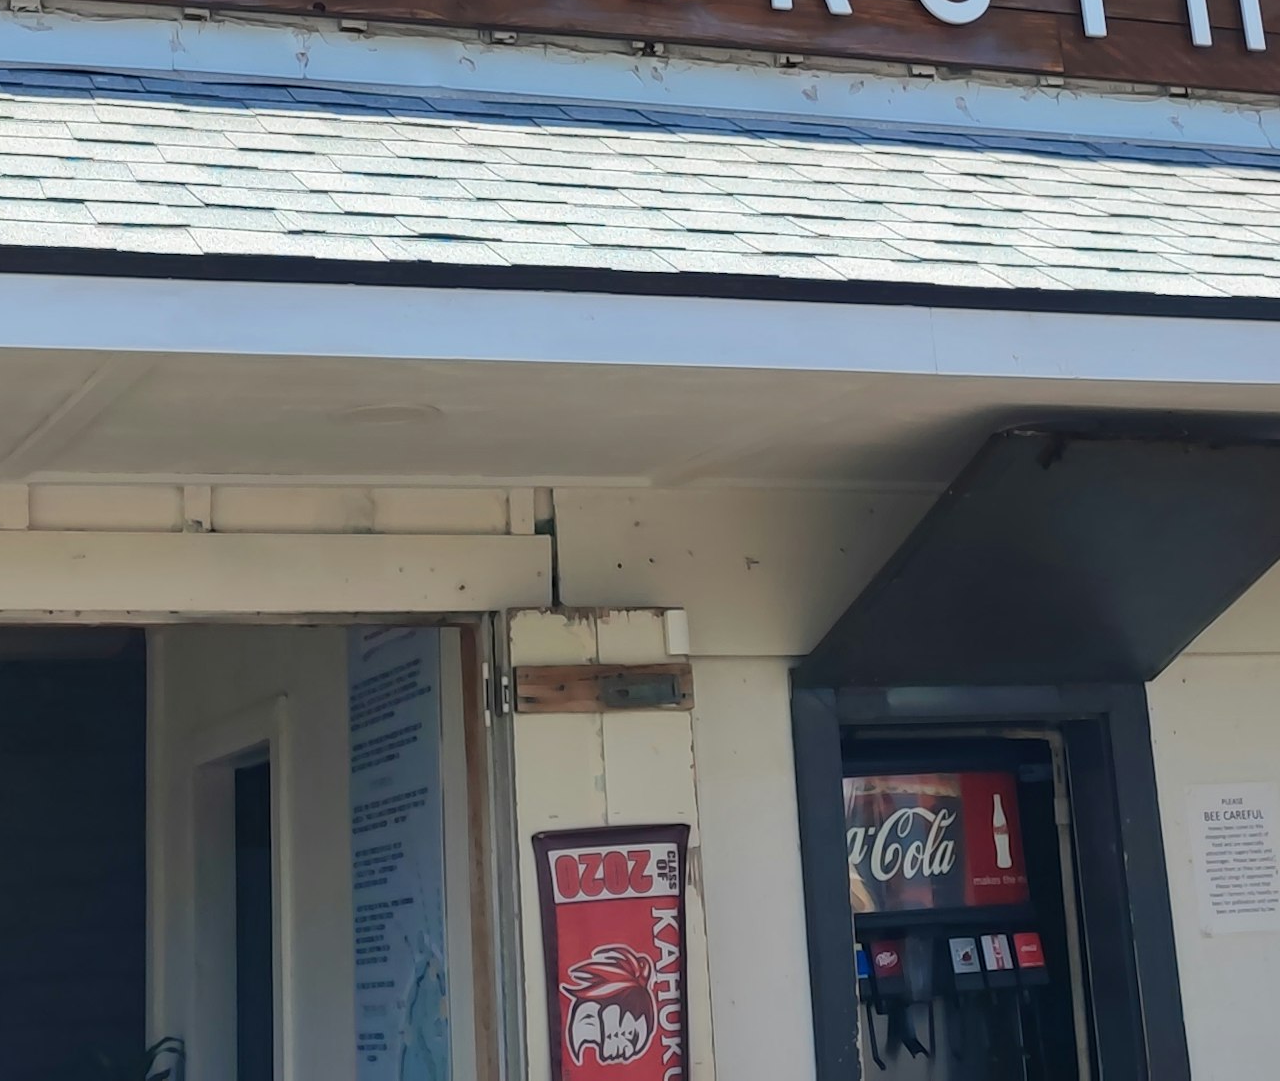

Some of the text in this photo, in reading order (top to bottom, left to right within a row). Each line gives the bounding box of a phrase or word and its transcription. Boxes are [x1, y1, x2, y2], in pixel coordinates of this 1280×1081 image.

[1203, 809, 1264, 822] BEE CAREFUL
[1221, 798, 1243, 806] PLEASE
[846, 806, 957, 882] a-Cola
[554, 849, 654, 900] 2020
[655, 858, 668, 881] OF
[666, 849, 678, 891] CLASS
